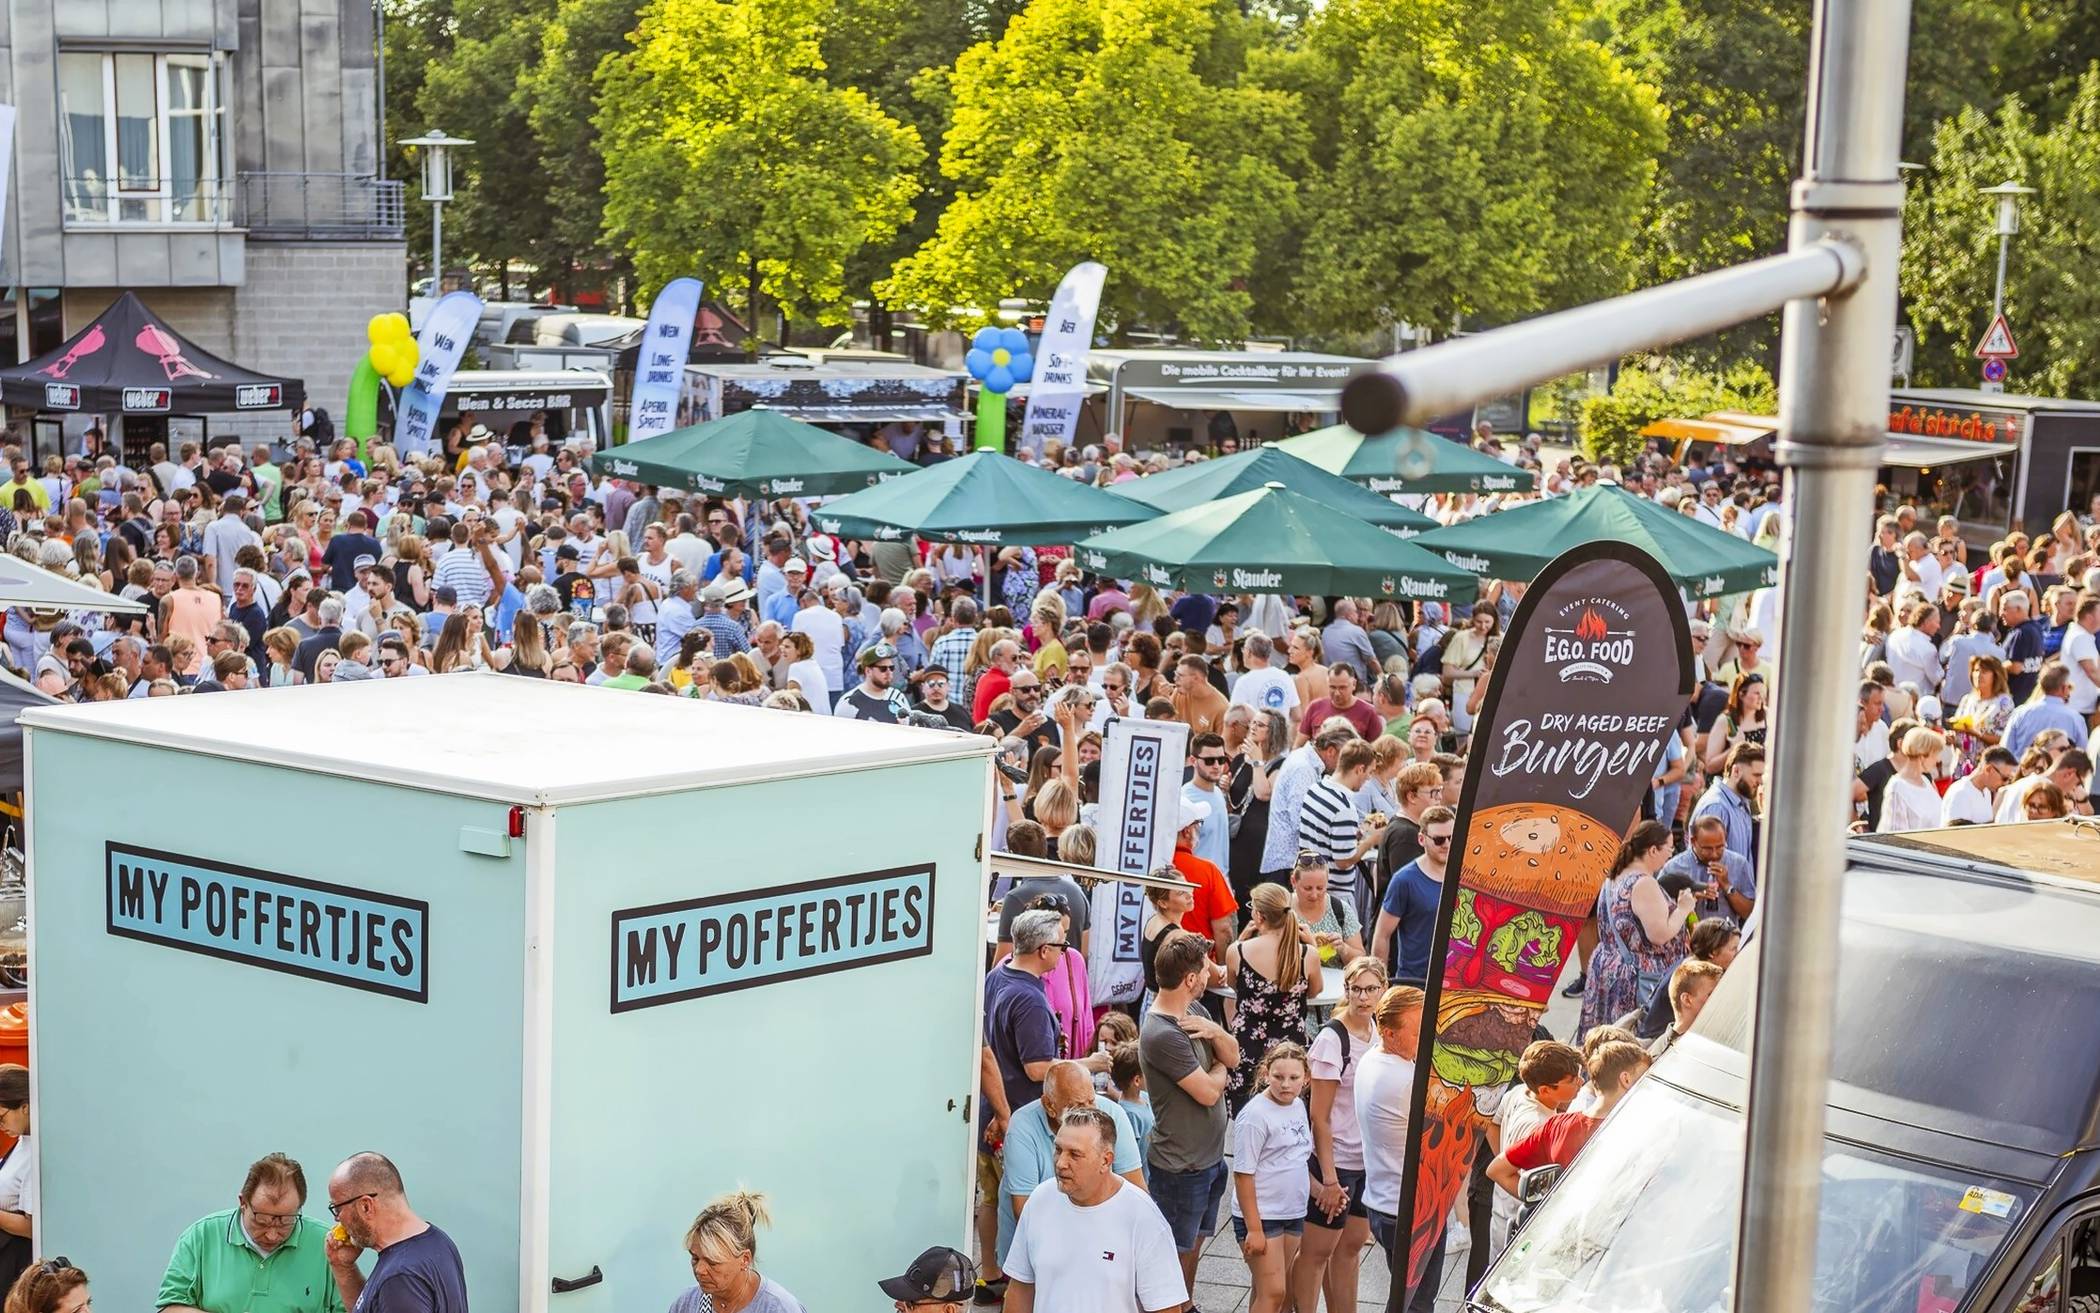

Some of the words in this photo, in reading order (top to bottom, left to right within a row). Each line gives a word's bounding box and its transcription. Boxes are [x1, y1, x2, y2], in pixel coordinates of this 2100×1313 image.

[1161, 364, 1180, 376] Die
[1182, 364, 1218, 377] mobile
[1220, 365, 1280, 377] Cocktailbar
[1281, 366, 1298, 377] für
[1299, 366, 1315, 377] Ihr
[1316, 366, 1350, 378] Event!
[457, 396, 489, 410] Wein
[492, 397, 505, 409] &
[506, 397, 545, 409] Secco
[1482, 475, 1516, 490] Stauder
[1232, 568, 1282, 589] Stauder
[1400, 576, 1448, 598] Stauder
[1559, 598, 1586, 617] EVENT
[1591, 597, 1630, 620] CATERING
[1544, 635, 1586, 663] E.G.O.
[1590, 638, 1634, 666] FOOD
[1540, 713, 1574, 732] DRY
[1575, 714, 1623, 732] AGED
[1625, 716, 1669, 732] BEEF
[1491, 719, 1660, 799] Burger
[1121, 745, 1154, 905] PFFERTJES
[118, 864, 168, 924] MY
[181, 876, 414, 977] POFFERTJES
[625, 922, 686, 988] MY
[698, 884, 922, 975] POFFERTJES
[1119, 915, 1137, 953] MY
